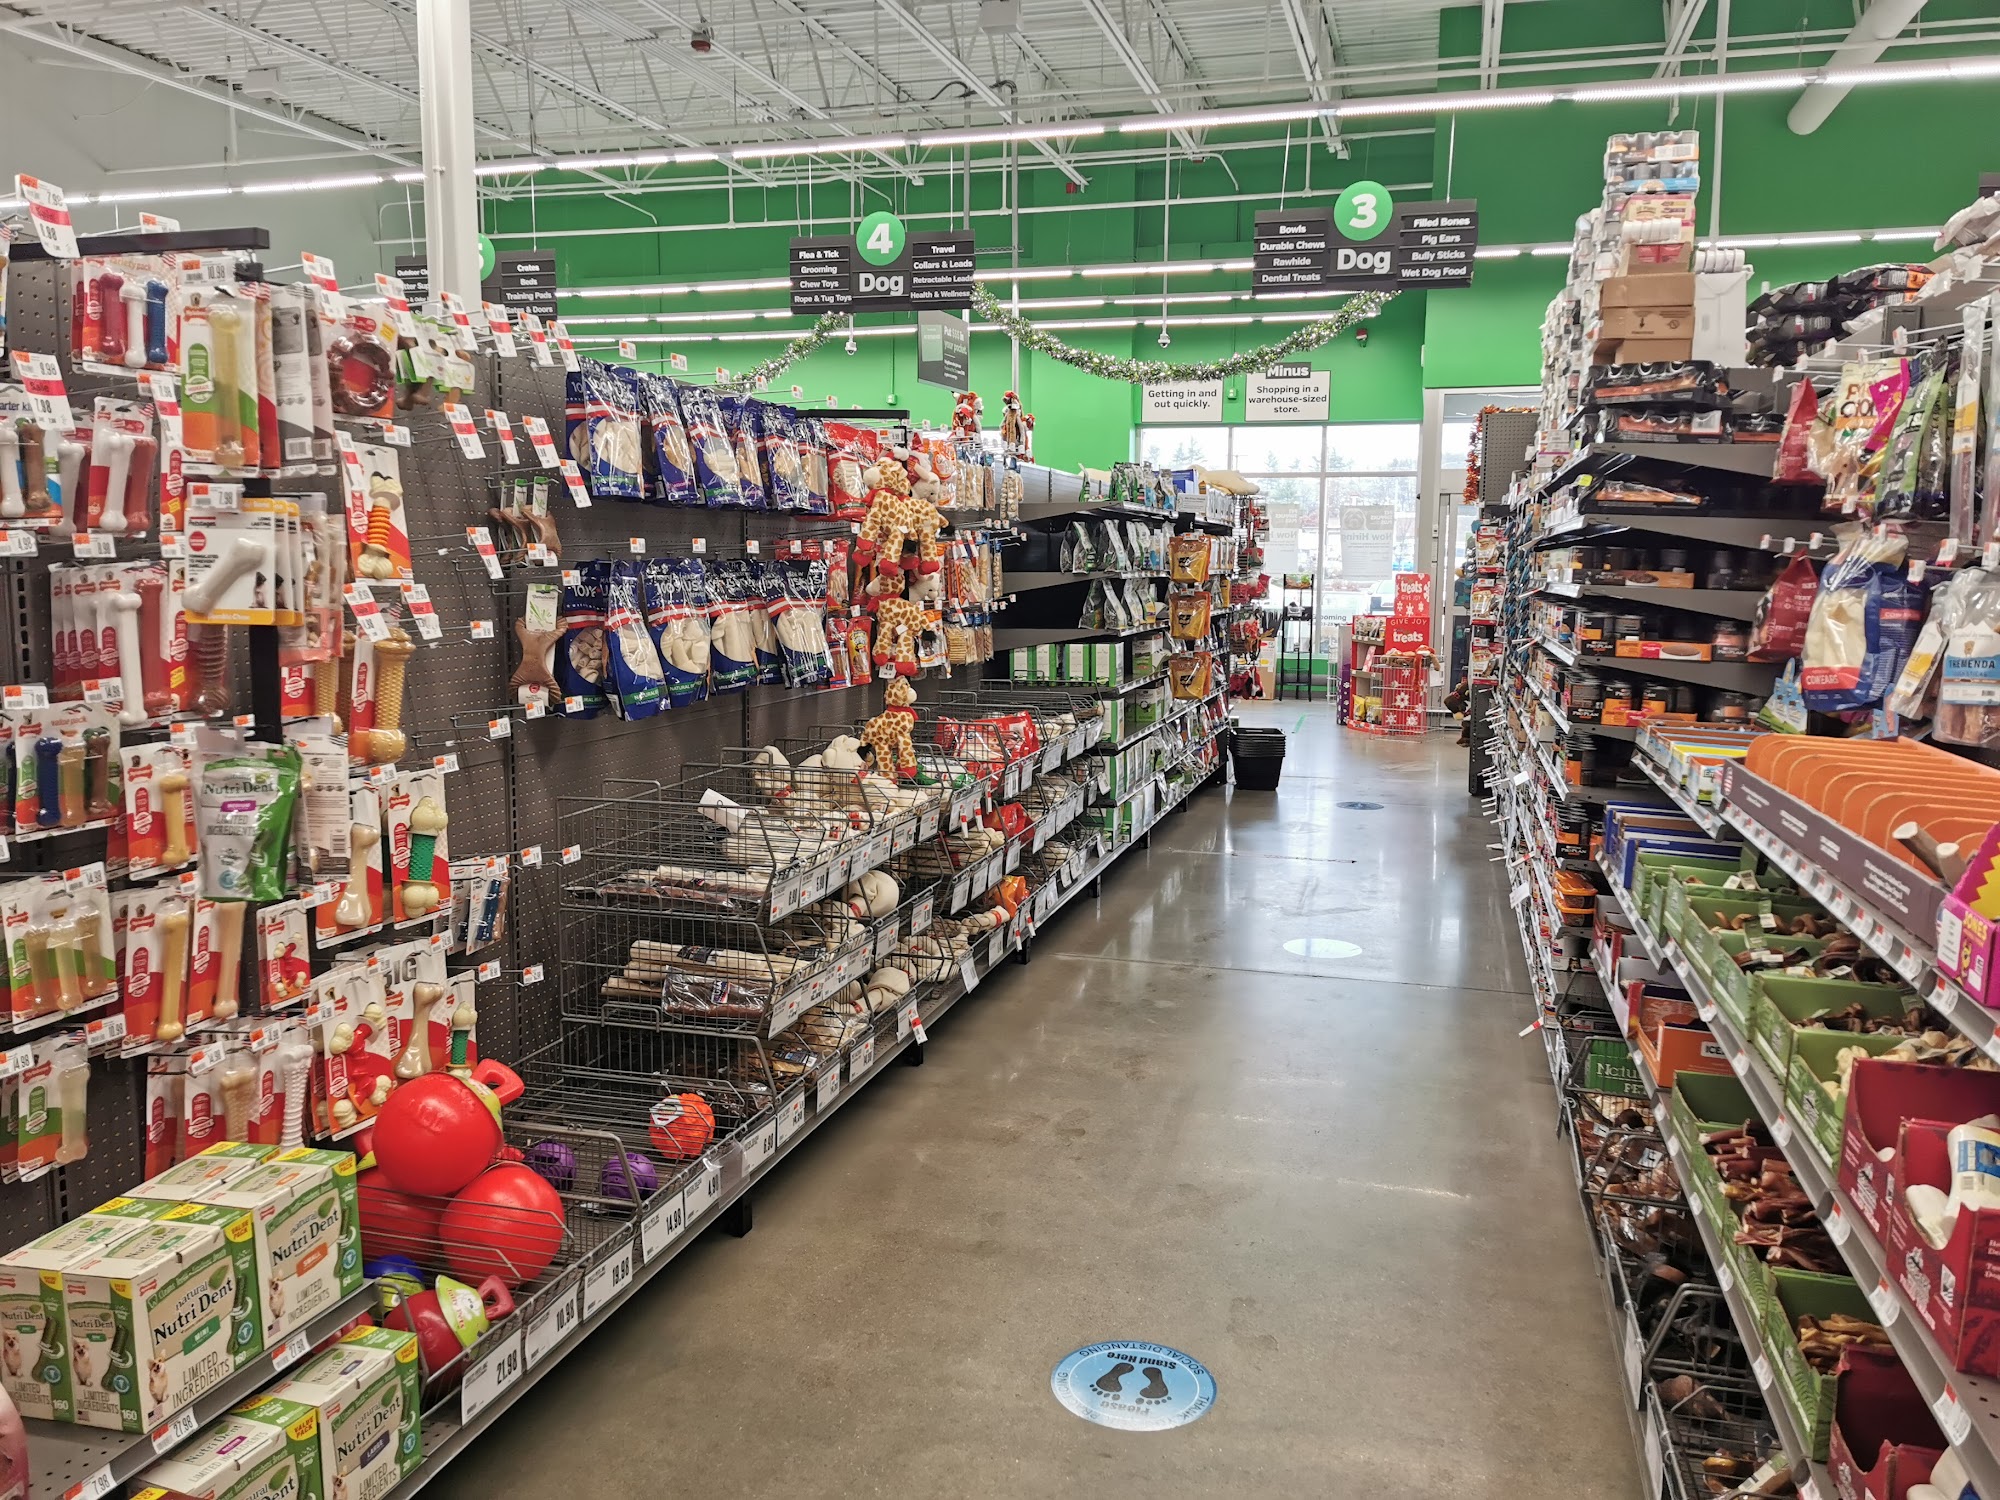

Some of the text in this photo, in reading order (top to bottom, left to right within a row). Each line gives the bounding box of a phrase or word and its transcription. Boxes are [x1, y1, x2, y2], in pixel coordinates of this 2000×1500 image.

[1349, 193, 1377, 229] 3
[1413, 217, 1470, 228] Filled Bones
[1279, 225, 1307, 234] Bowls
[866, 223, 893, 254] 4
[1421, 234, 1461, 245] Pig Ears
[931, 245, 956, 254] Travel
[1260, 240, 1326, 251] Durable Chews
[799, 250, 839, 259] Flea & Tick
[1411, 250, 1465, 261] Bully Sticks
[913, 259, 973, 269] Collars & Leads
[1273, 257, 1311, 266] Rawhide
[1337, 249, 1391, 275] Dog
[397, 269, 419, 277] Outdoor
[517, 264, 540, 272] Crates
[801, 266, 837, 275] Grooming
[1401, 266, 1467, 278] Wet Dog Food
[520, 278, 538, 286] Beds
[800, 279, 839, 288] Chew Toys
[913, 274, 974, 284] Retractable Leads
[1261, 273, 1321, 283] Dental Treats
[859, 273, 904, 296] Dog
[505, 291, 552, 301] Training Pads
[794, 295, 813, 304] Rope
[820, 294, 834, 303] Tug
[834, 293, 852, 302] Toys
[910, 291, 933, 299] Health
[940, 289, 970, 298] Wellness
[532, 305, 553, 313] Doors
[1267, 365, 1309, 377] Minus
[1148, 389, 1217, 399] Getting in and
[1256, 385, 1300, 395] Shopping
[1302, 385, 1311, 393] in
[1154, 399, 1210, 409] out quickly.
[1248, 395, 1327, 404] warehouse-sized
[1400, 580, 1423, 594] treats
[1390, 617, 1427, 626] GIVE JOY
[1392, 631, 1423, 643] treats
[1949, 659, 1996, 669] TREMENDA
[203, 782, 275, 795] Nutri Dent
[1597, 1062, 1641, 1078] Natu
[231, 1220, 249, 1234] VALUE
[666, 1207, 682, 1236] 14.98
[272, 1208, 339, 1267] Nutri Dent
[612, 1256, 630, 1288] 19.98
[175, 1281, 208, 1311] natural
[154, 1277, 233, 1345] Nutri Dent
[556, 1298, 575, 1332] 10.98
[71, 1319, 114, 1328] Nutri Dent
[1079, 1341, 1204, 1376] SOCIAL DISTANCING
[1107, 1351, 1176, 1370] Stand Here
[183, 1351, 218, 1385] LIMITED
[496, 1348, 518, 1385] 21.98
[14, 1383, 41, 1394] LIMITED
[172, 1358, 230, 1409] INGREDIENTS
[83, 1390, 110, 1402] LIMITED
[53, 1400, 69, 1410] 160
[77, 1399, 120, 1414] INGREDIENTS
[1100, 1401, 1151, 1416] Please
[1182, 1394, 1209, 1420] THANK
[122, 1410, 138, 1421] 160
[173, 1414, 194, 1438] 27.98
[294, 1416, 314, 1431] VALUE
[337, 1396, 401, 1463] Nutri Dent
[296, 1423, 314, 1440] PACK
[184, 1442, 216, 1464] Nutri
[217, 1424, 243, 1443] Dent
[188, 1459, 222, 1483] LIMITED
[91, 1473, 110, 1494] 7.98
[359, 1462, 388, 1494] LIMITED
